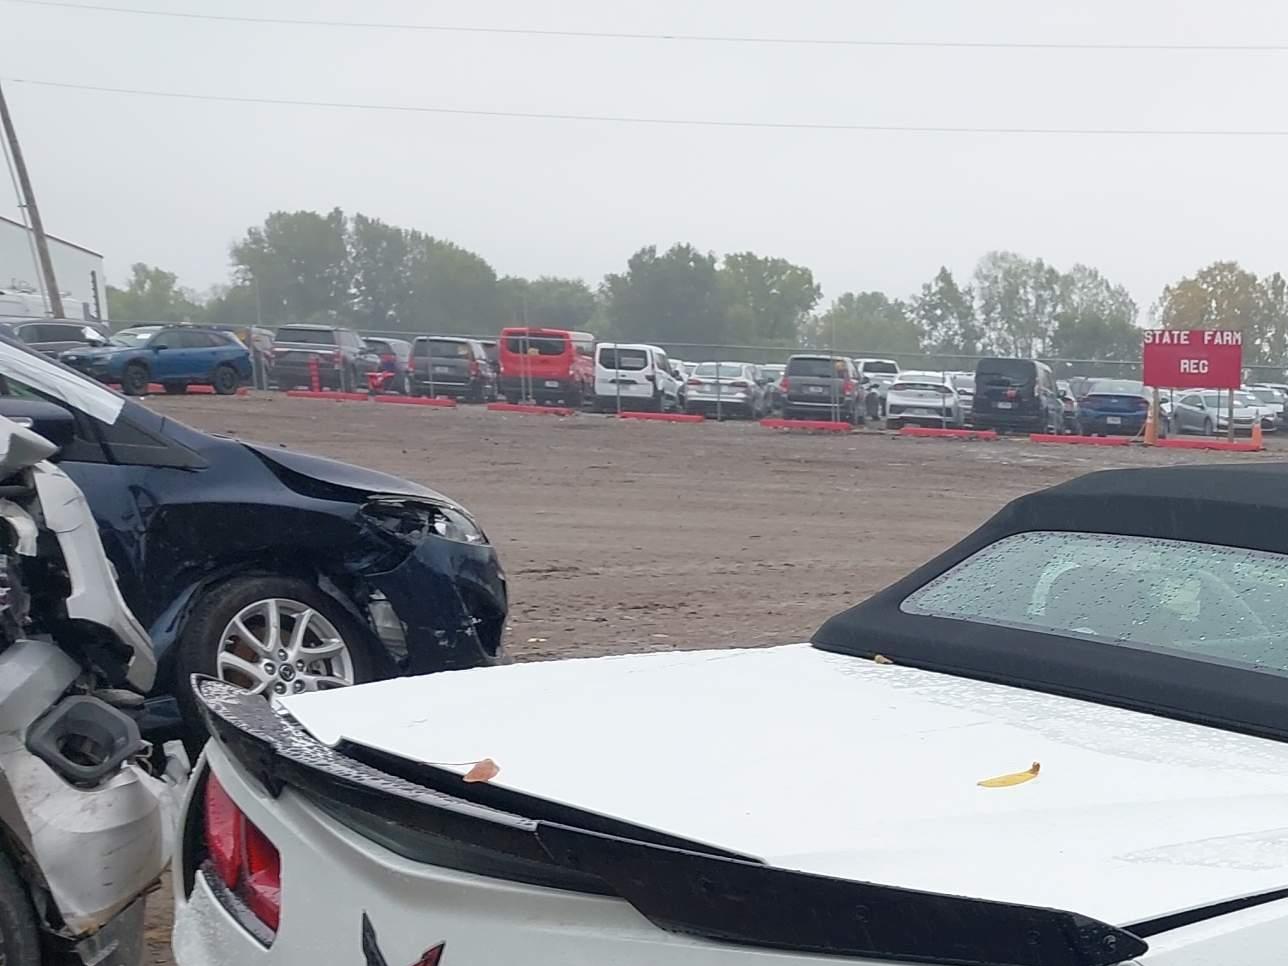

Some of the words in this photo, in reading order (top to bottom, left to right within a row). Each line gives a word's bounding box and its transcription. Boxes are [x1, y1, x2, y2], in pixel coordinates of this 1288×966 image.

[1143, 330, 1190, 345] STATE
[1203, 331, 1242, 346] FARM
[1180, 359, 1209, 374] REG
